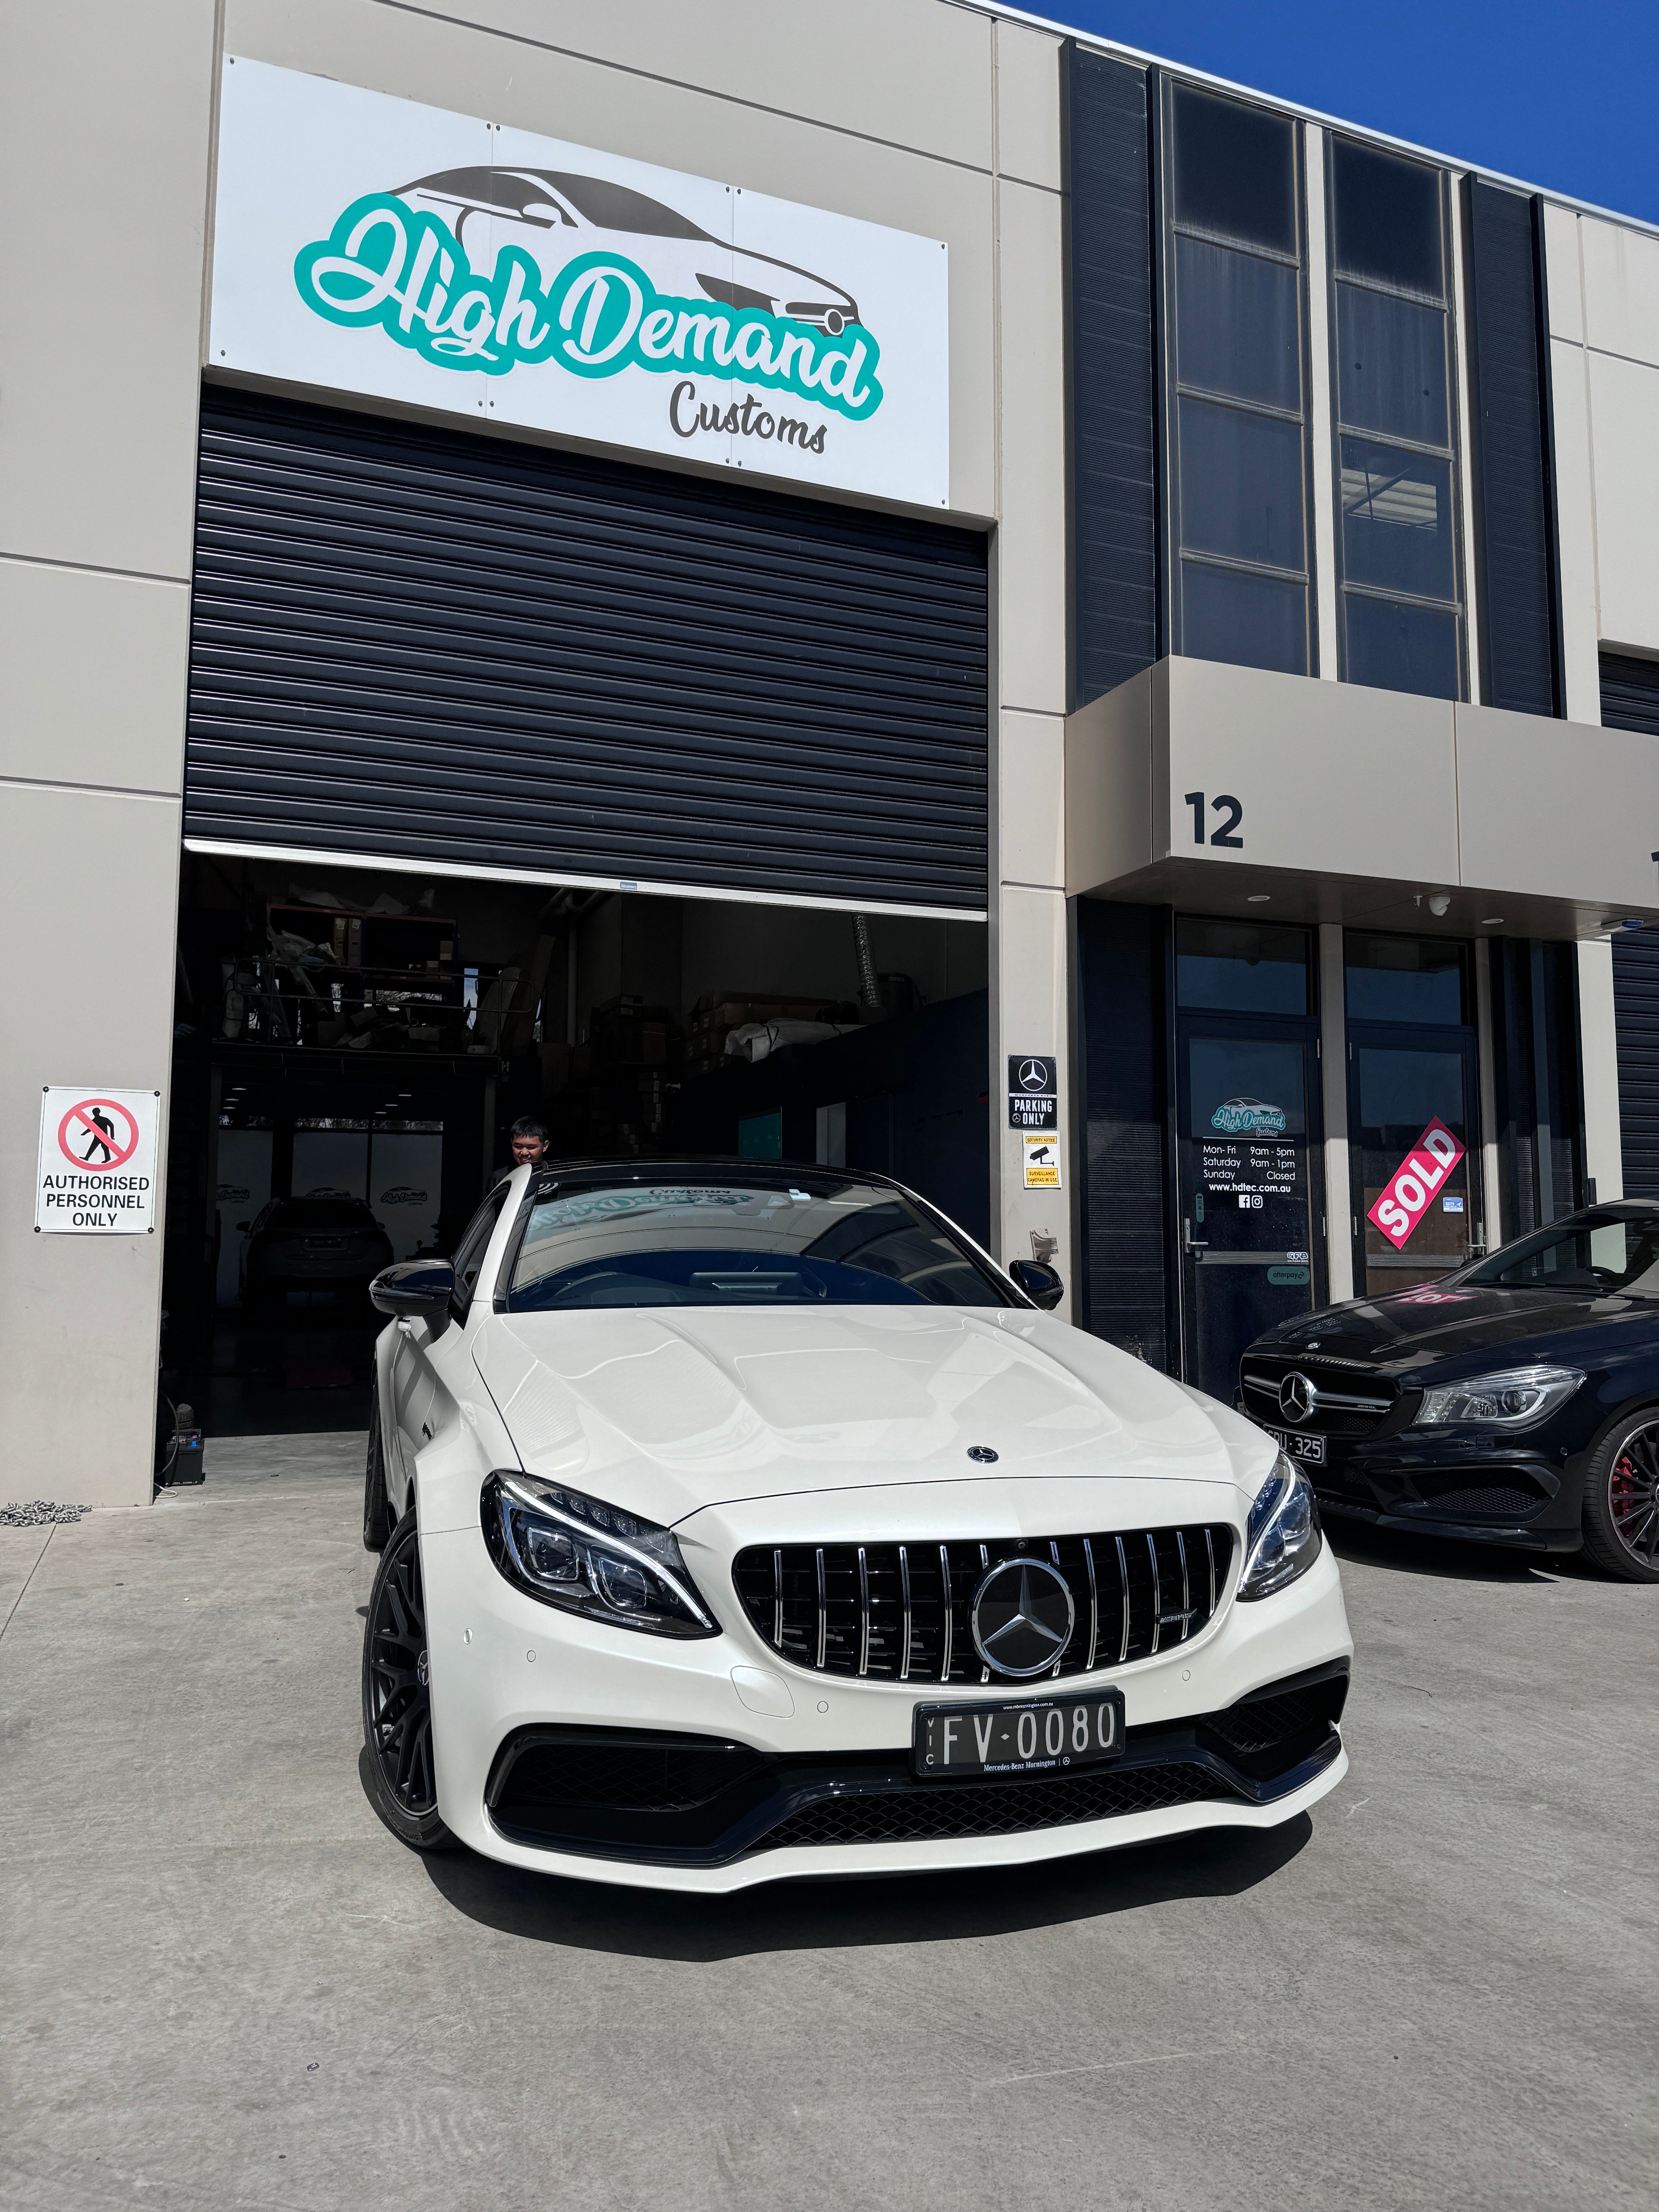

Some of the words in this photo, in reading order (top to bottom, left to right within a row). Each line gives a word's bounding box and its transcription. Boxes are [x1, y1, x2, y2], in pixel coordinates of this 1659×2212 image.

[311, 208, 551, 361] High
[558, 266, 871, 407] Demand
[668, 380, 828, 455] Customs
[1184, 791, 1243, 848] 12
[1014, 1099, 1052, 1113] PARKING
[1022, 1113, 1045, 1125] ONLY
[1213, 1109, 1242, 1129] High
[1242, 1110, 1284, 1128] Demand
[1256, 1127, 1278, 1137] Customs
[1250, 1146, 1269, 1156] 9am
[1276, 1147, 1295, 1157] 5pm
[1203, 1157, 1241, 1168] Saturday
[1250, 1158, 1269, 1168] 9am
[1277, 1159, 1295, 1170] 1pm
[1203, 1169, 1235, 1180] Sunday
[1266, 1171, 1295, 1180] Closed
[43, 1175, 149, 1190] AUTHORISED
[1209, 1182, 1291, 1193] www.hdtec.com.au
[1378, 1129, 1456, 1237] SOLD
[46, 1194, 145, 1209] PERSONNEL
[72, 1212, 118, 1226] ONLY
[1295, 1437, 1321, 1458] 325
[983, 1762, 1025, 1772] Mercedes-Benz
[1025, 1759, 1056, 1771] Mornington
